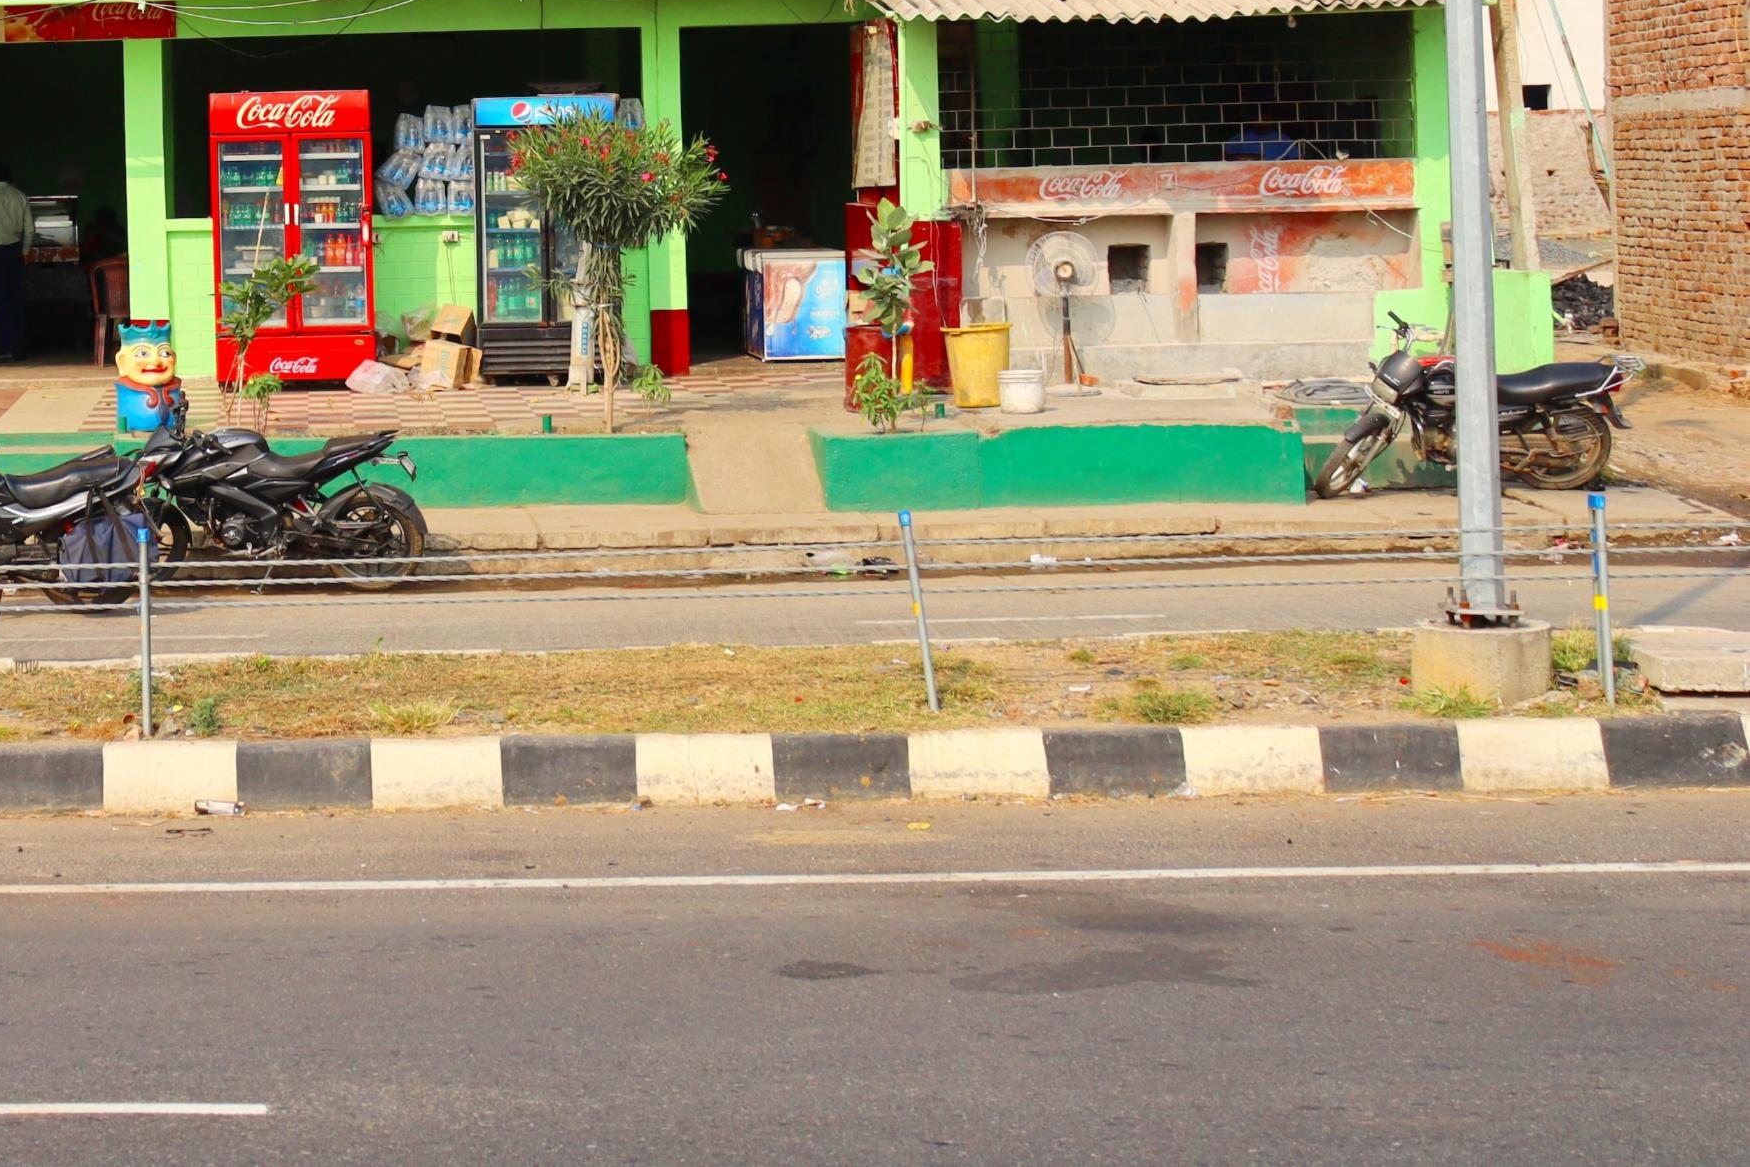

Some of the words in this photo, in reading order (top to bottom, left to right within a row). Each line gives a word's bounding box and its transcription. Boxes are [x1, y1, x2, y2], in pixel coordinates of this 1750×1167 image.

[236, 94, 342, 129] Coca-Cola
[1039, 168, 1132, 201] Coca-Cola
[1259, 165, 1349, 197] Coca-Cola
[269, 356, 320, 374] Coca-Cola
